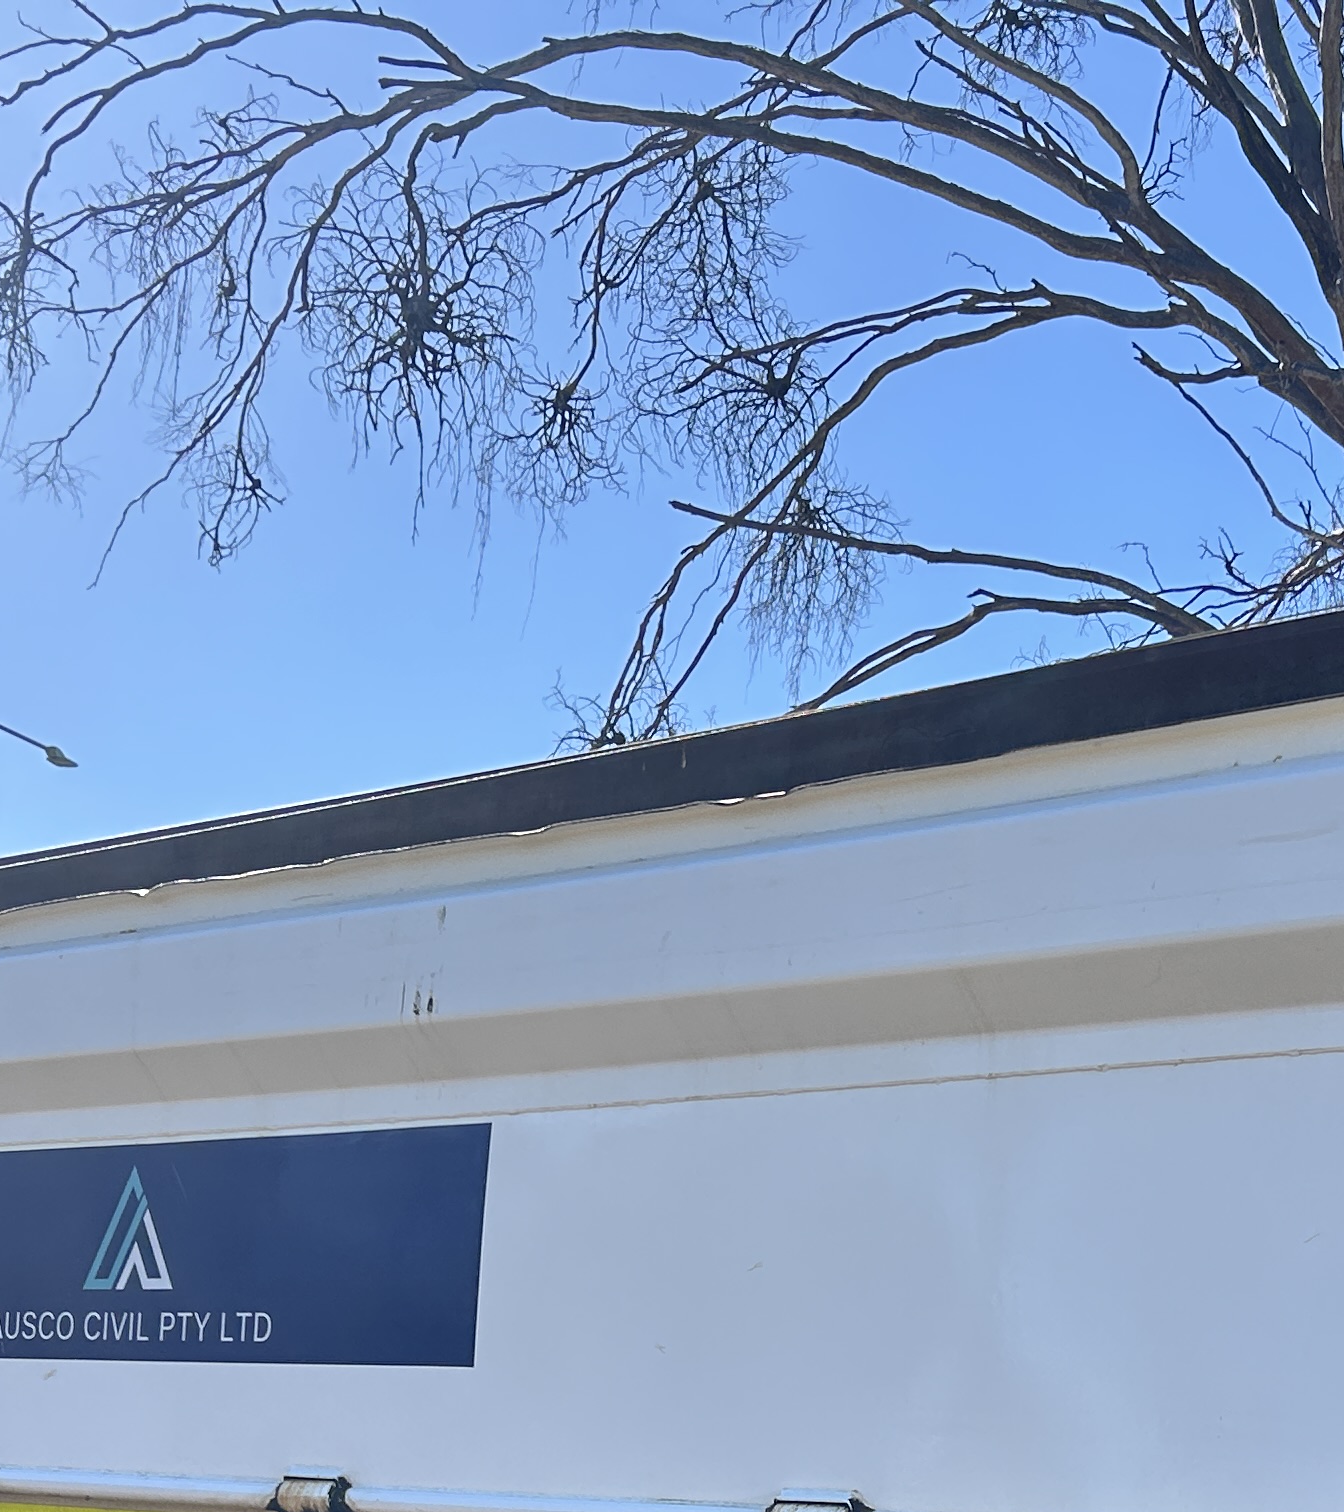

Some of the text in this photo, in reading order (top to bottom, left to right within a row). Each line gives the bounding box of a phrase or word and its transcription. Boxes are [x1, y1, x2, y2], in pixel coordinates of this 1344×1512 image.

[84, 1311, 149, 1341] CIVIL
[159, 1312, 211, 1341] PTY
[220, 1312, 272, 1342] LTD
